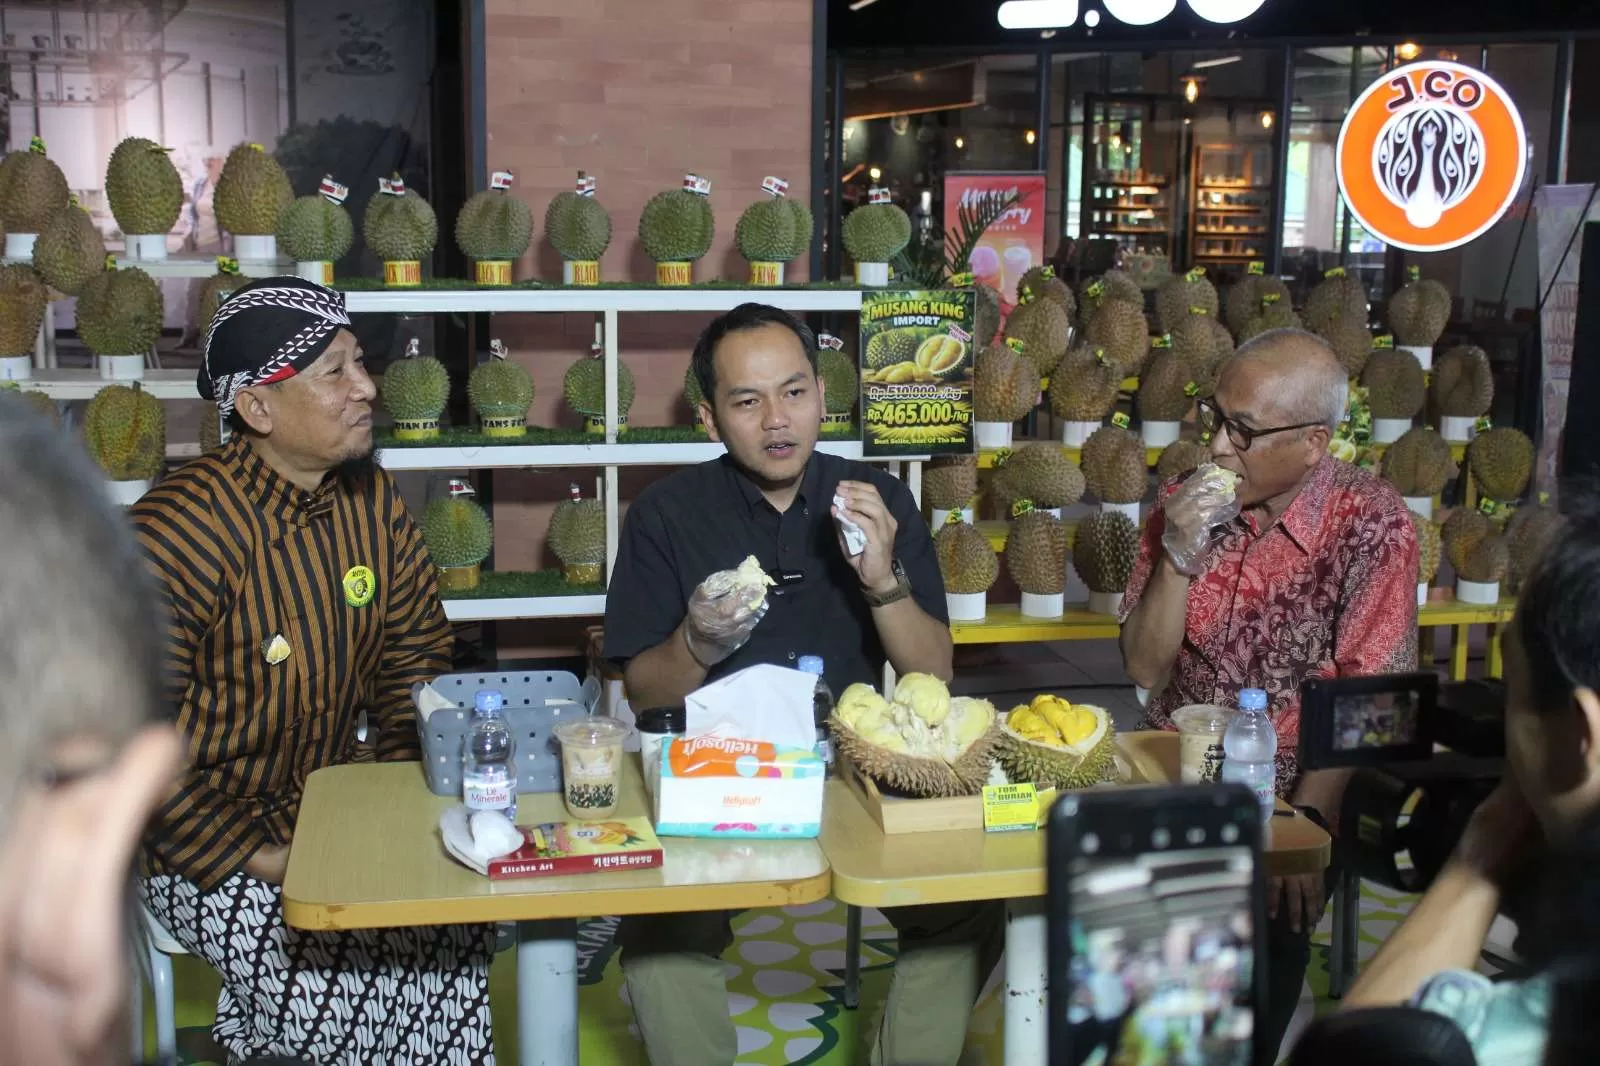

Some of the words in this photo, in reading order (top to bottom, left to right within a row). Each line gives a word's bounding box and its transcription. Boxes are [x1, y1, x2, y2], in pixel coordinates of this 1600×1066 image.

[1388, 70, 1481, 109] J.CO
[871, 300, 929, 319] MUSANG
[931, 301, 964, 320] KING
[893, 315, 940, 326] IMPORT
[501, 864, 537, 875] Kitchen
[539, 862, 554, 872] Art
